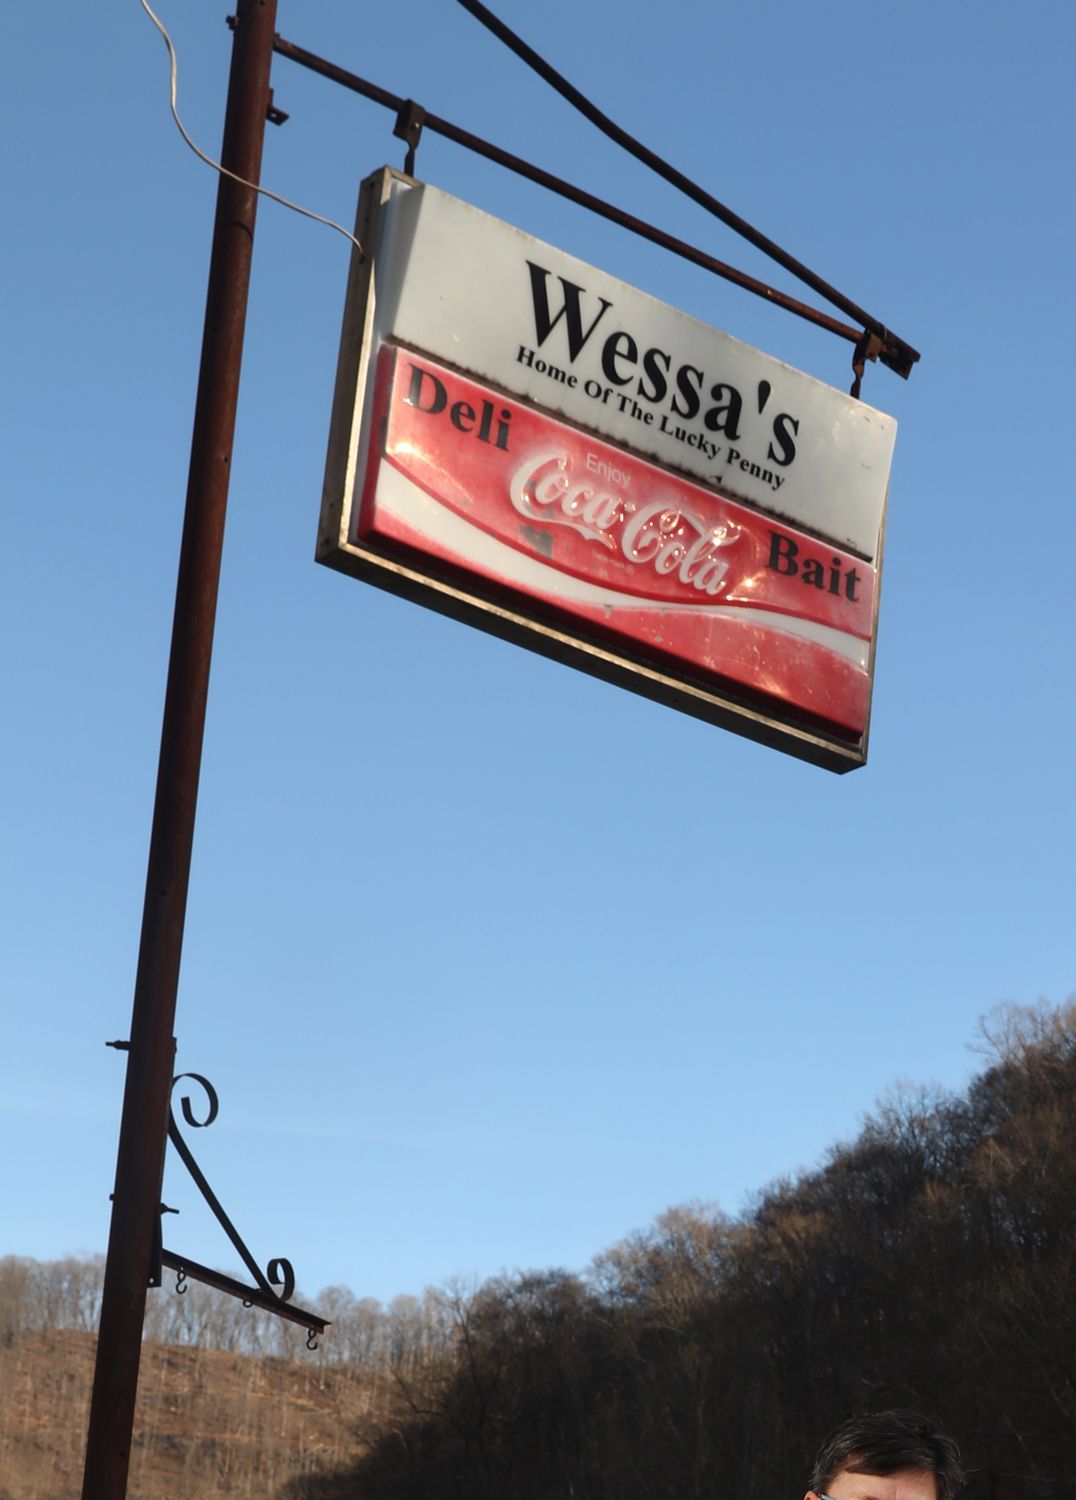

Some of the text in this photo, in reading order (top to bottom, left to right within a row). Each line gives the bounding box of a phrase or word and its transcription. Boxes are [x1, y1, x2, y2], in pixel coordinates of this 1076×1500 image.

[402, 364, 511, 453] Deli
[516, 345, 787, 491] Home Of The Lucky Penny
[525, 260, 800, 467] Wessa's
[510, 451, 742, 596] Coca-Cola
[585, 452, 632, 488] Enjoy
[765, 530, 862, 603] Bait
